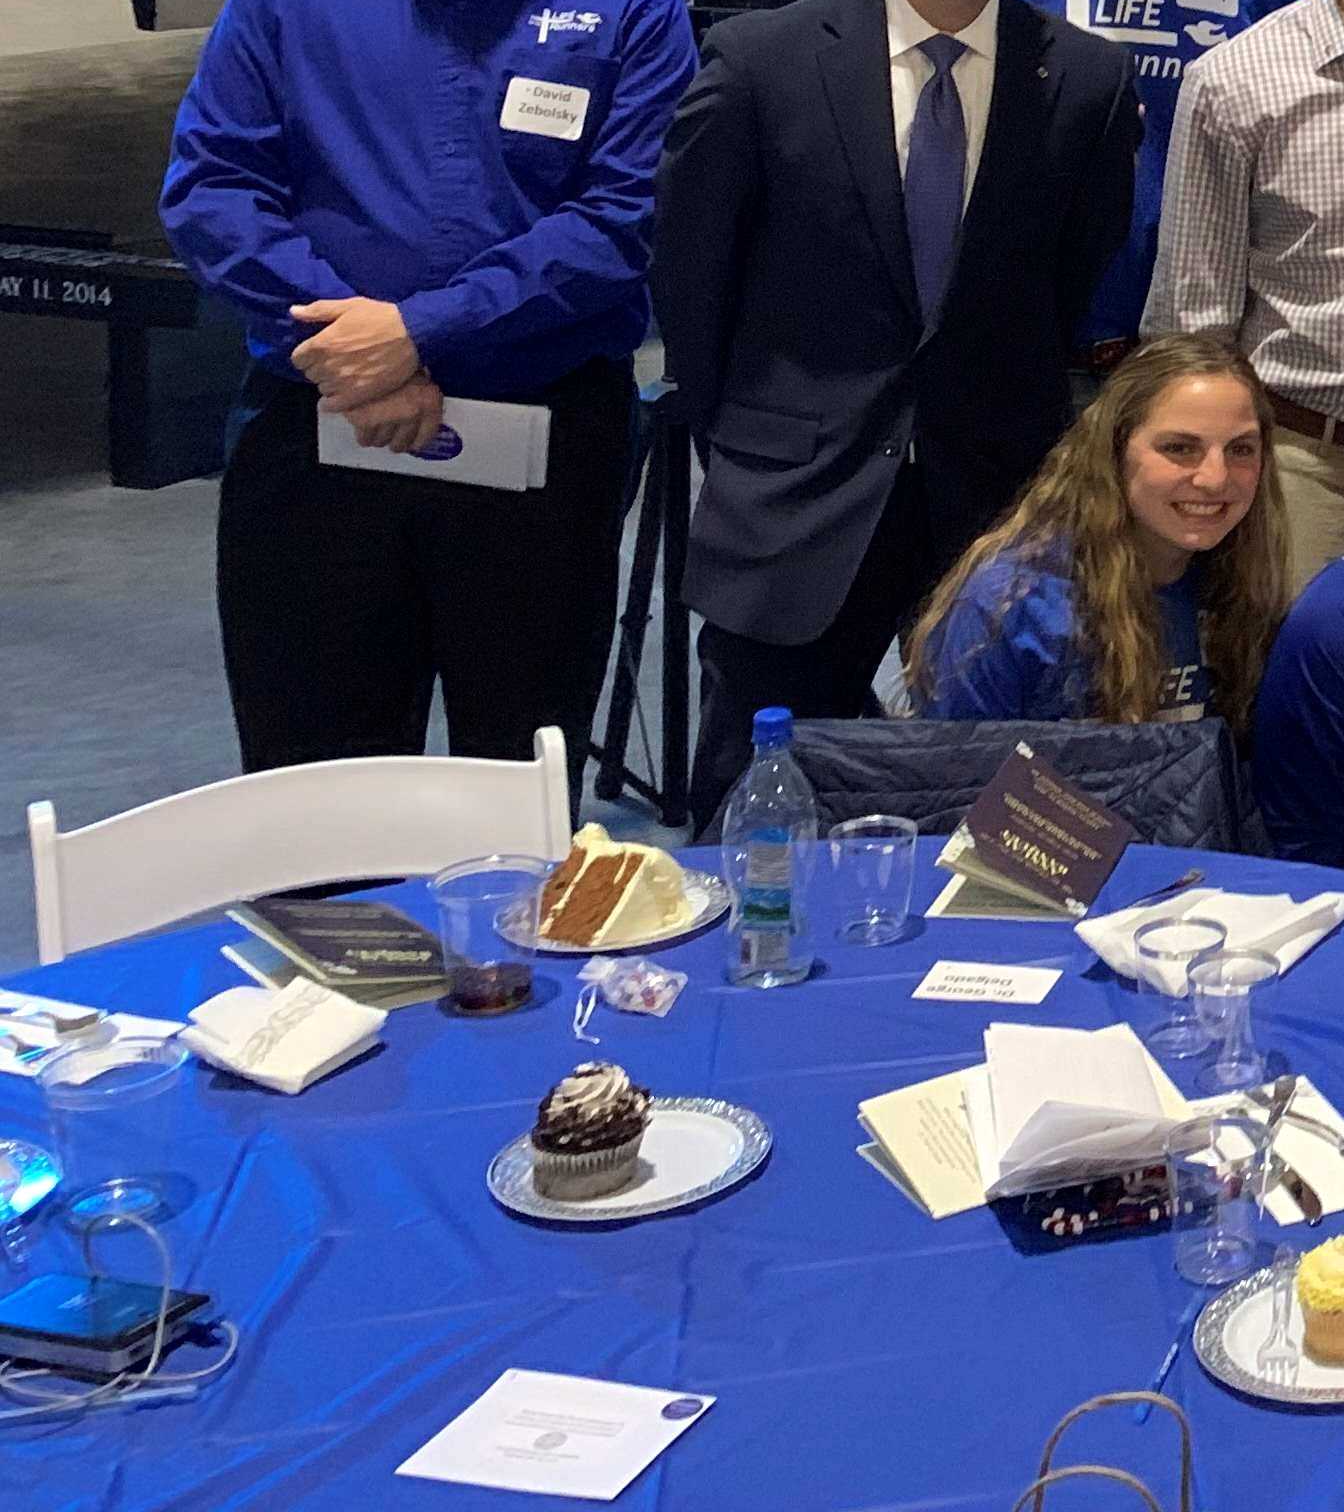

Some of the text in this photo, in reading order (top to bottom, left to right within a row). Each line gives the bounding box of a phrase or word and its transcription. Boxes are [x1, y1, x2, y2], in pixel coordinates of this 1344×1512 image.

[532, 86, 573, 102] David
[518, 102, 578, 124] Zebolsky
[62, 281, 113, 306] 2014
[944, 974, 1013, 986] Delgado
[926, 984, 986, 996] George
